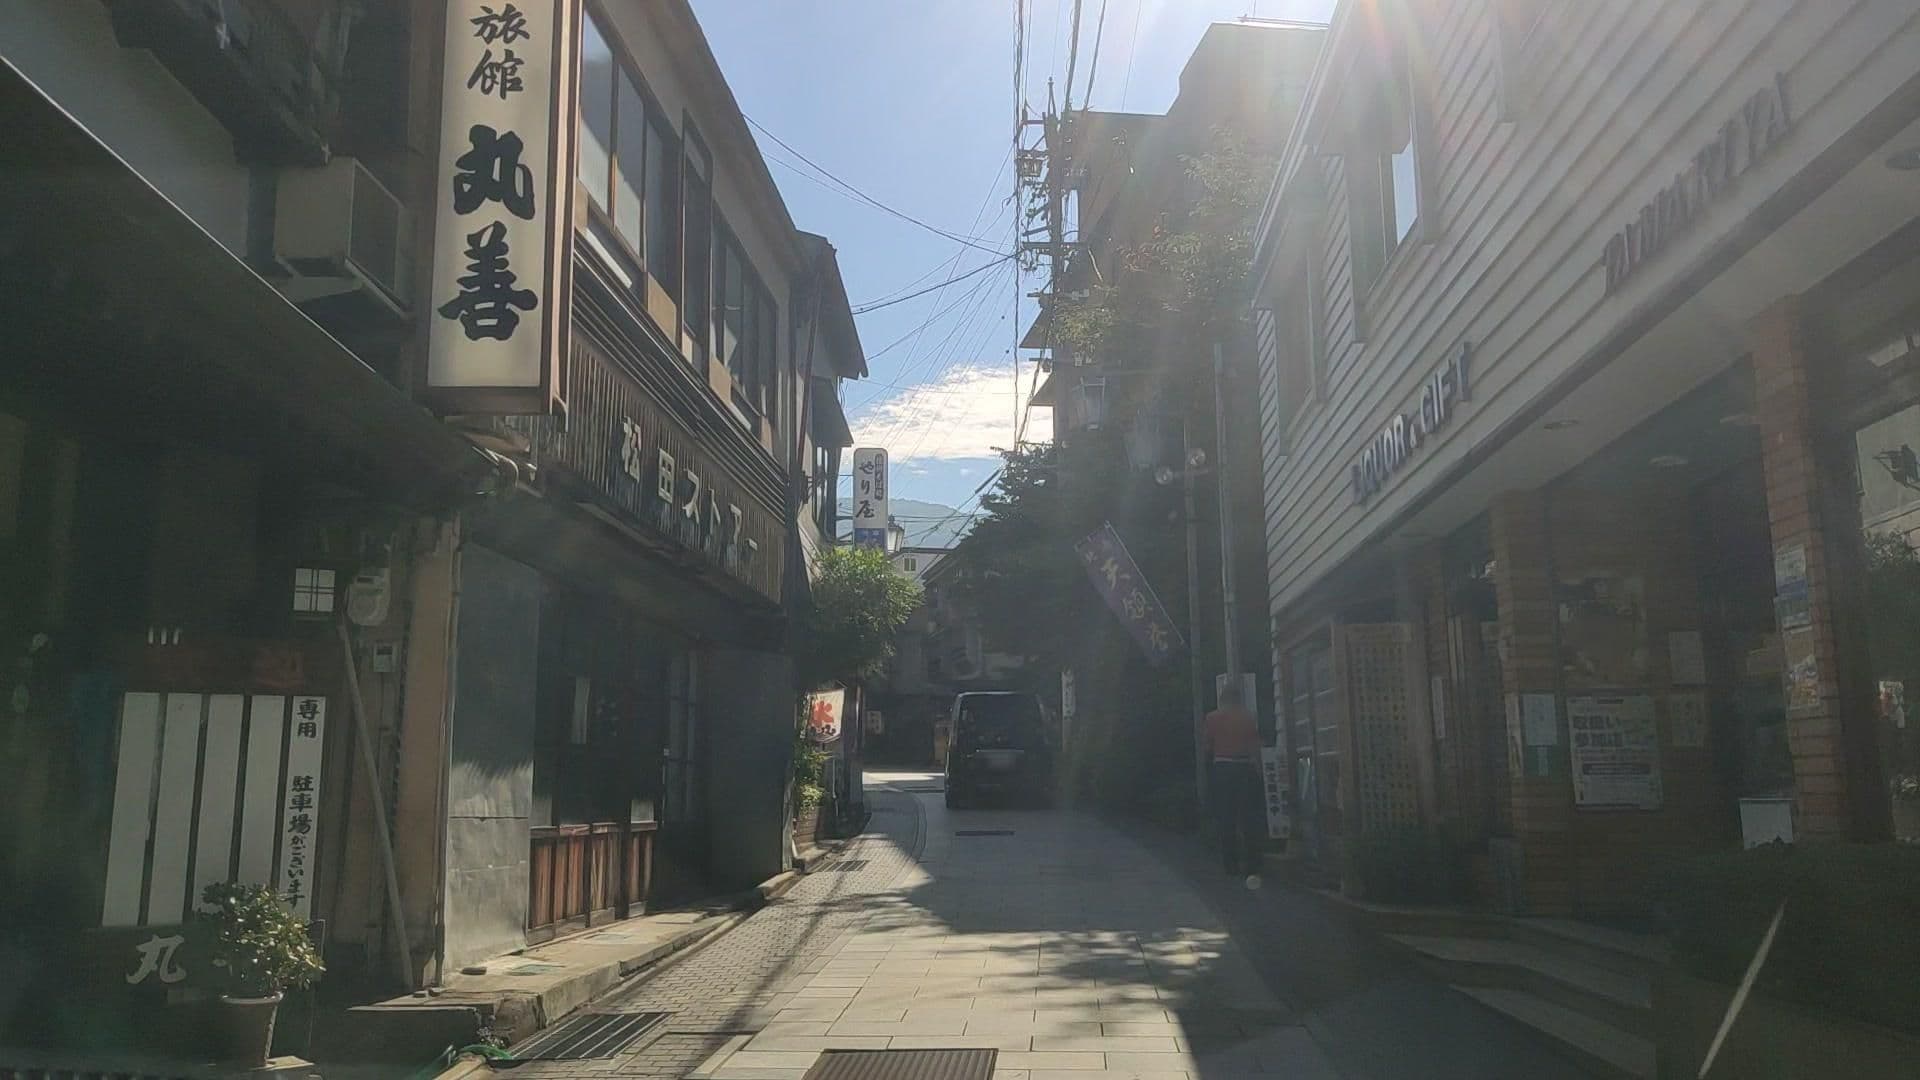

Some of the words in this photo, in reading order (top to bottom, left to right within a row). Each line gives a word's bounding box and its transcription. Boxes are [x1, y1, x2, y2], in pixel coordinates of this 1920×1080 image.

[468, 3, 531, 100] 旅館
[436, 123, 539, 341] 丸善
[1419, 341, 1472, 434] GIFT
[620, 416, 759, 552] 松田ストアー
[856, 461, 875, 519] やり屋
[297, 699, 321, 738] 専用
[811, 700, 835, 728] 氷
[284, 775, 315, 908] 駐車場がございます
